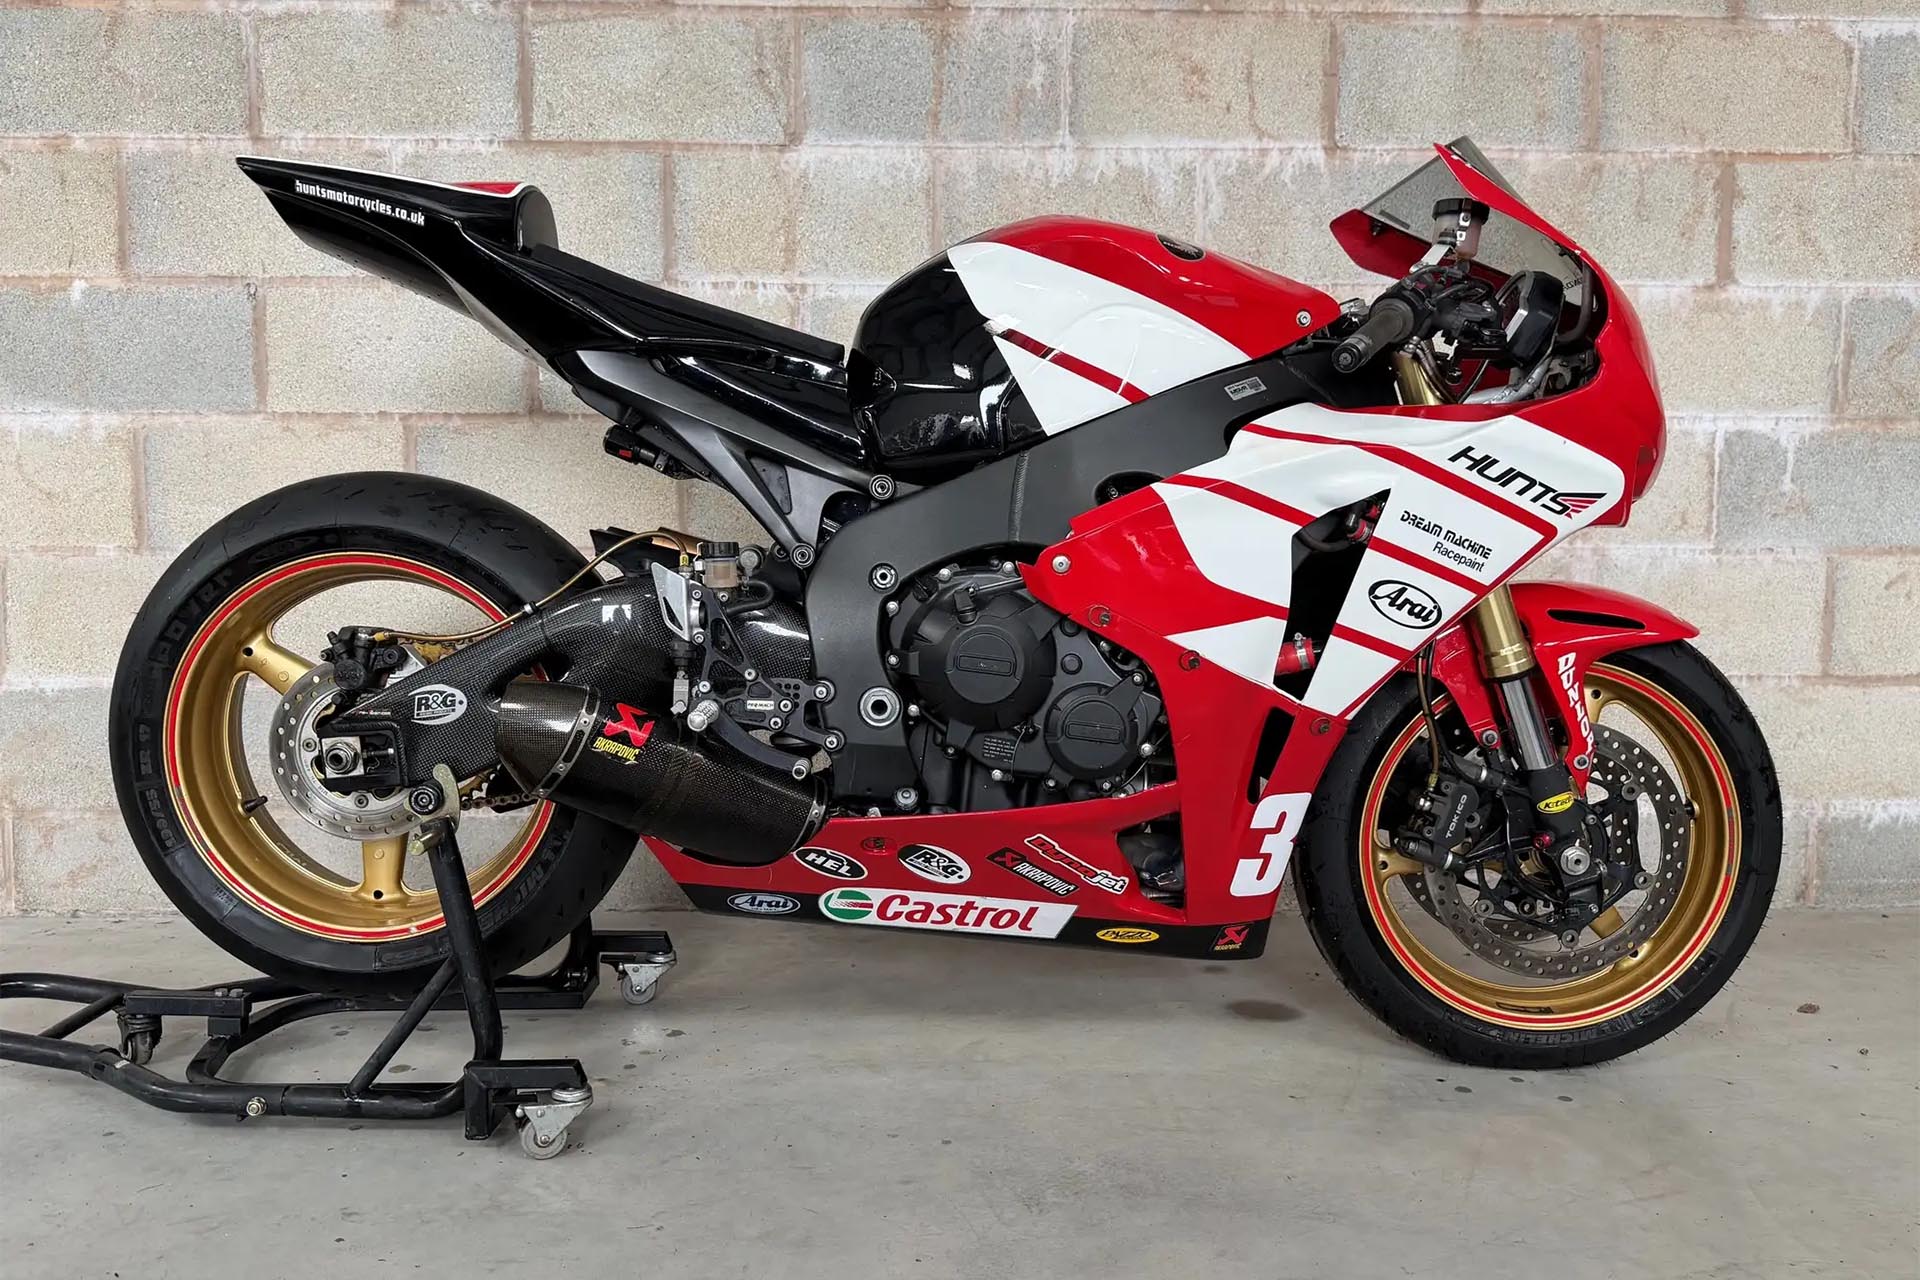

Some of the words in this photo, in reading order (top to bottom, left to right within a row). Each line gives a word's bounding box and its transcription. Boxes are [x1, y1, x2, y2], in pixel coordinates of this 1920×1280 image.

[294, 179, 425, 226] huntsmotorcycles.co.uk
[1447, 445, 1607, 516] HUNTS
[1400, 510, 1443, 538] DREAM
[1432, 541, 1485, 573] Racepaint
[1371, 586, 1439, 622] Arai
[416, 692, 457, 712] R&G
[1557, 652, 1595, 756] DUNLOP
[1445, 794, 1468, 839] TOKICO
[1230, 792, 1312, 897] 3
[805, 852, 852, 877] HEL
[917, 849, 965, 878] R&G
[1027, 836, 1127, 893] Dynojet
[736, 895, 790, 910] Arai
[876, 894, 1040, 932] Castrol
